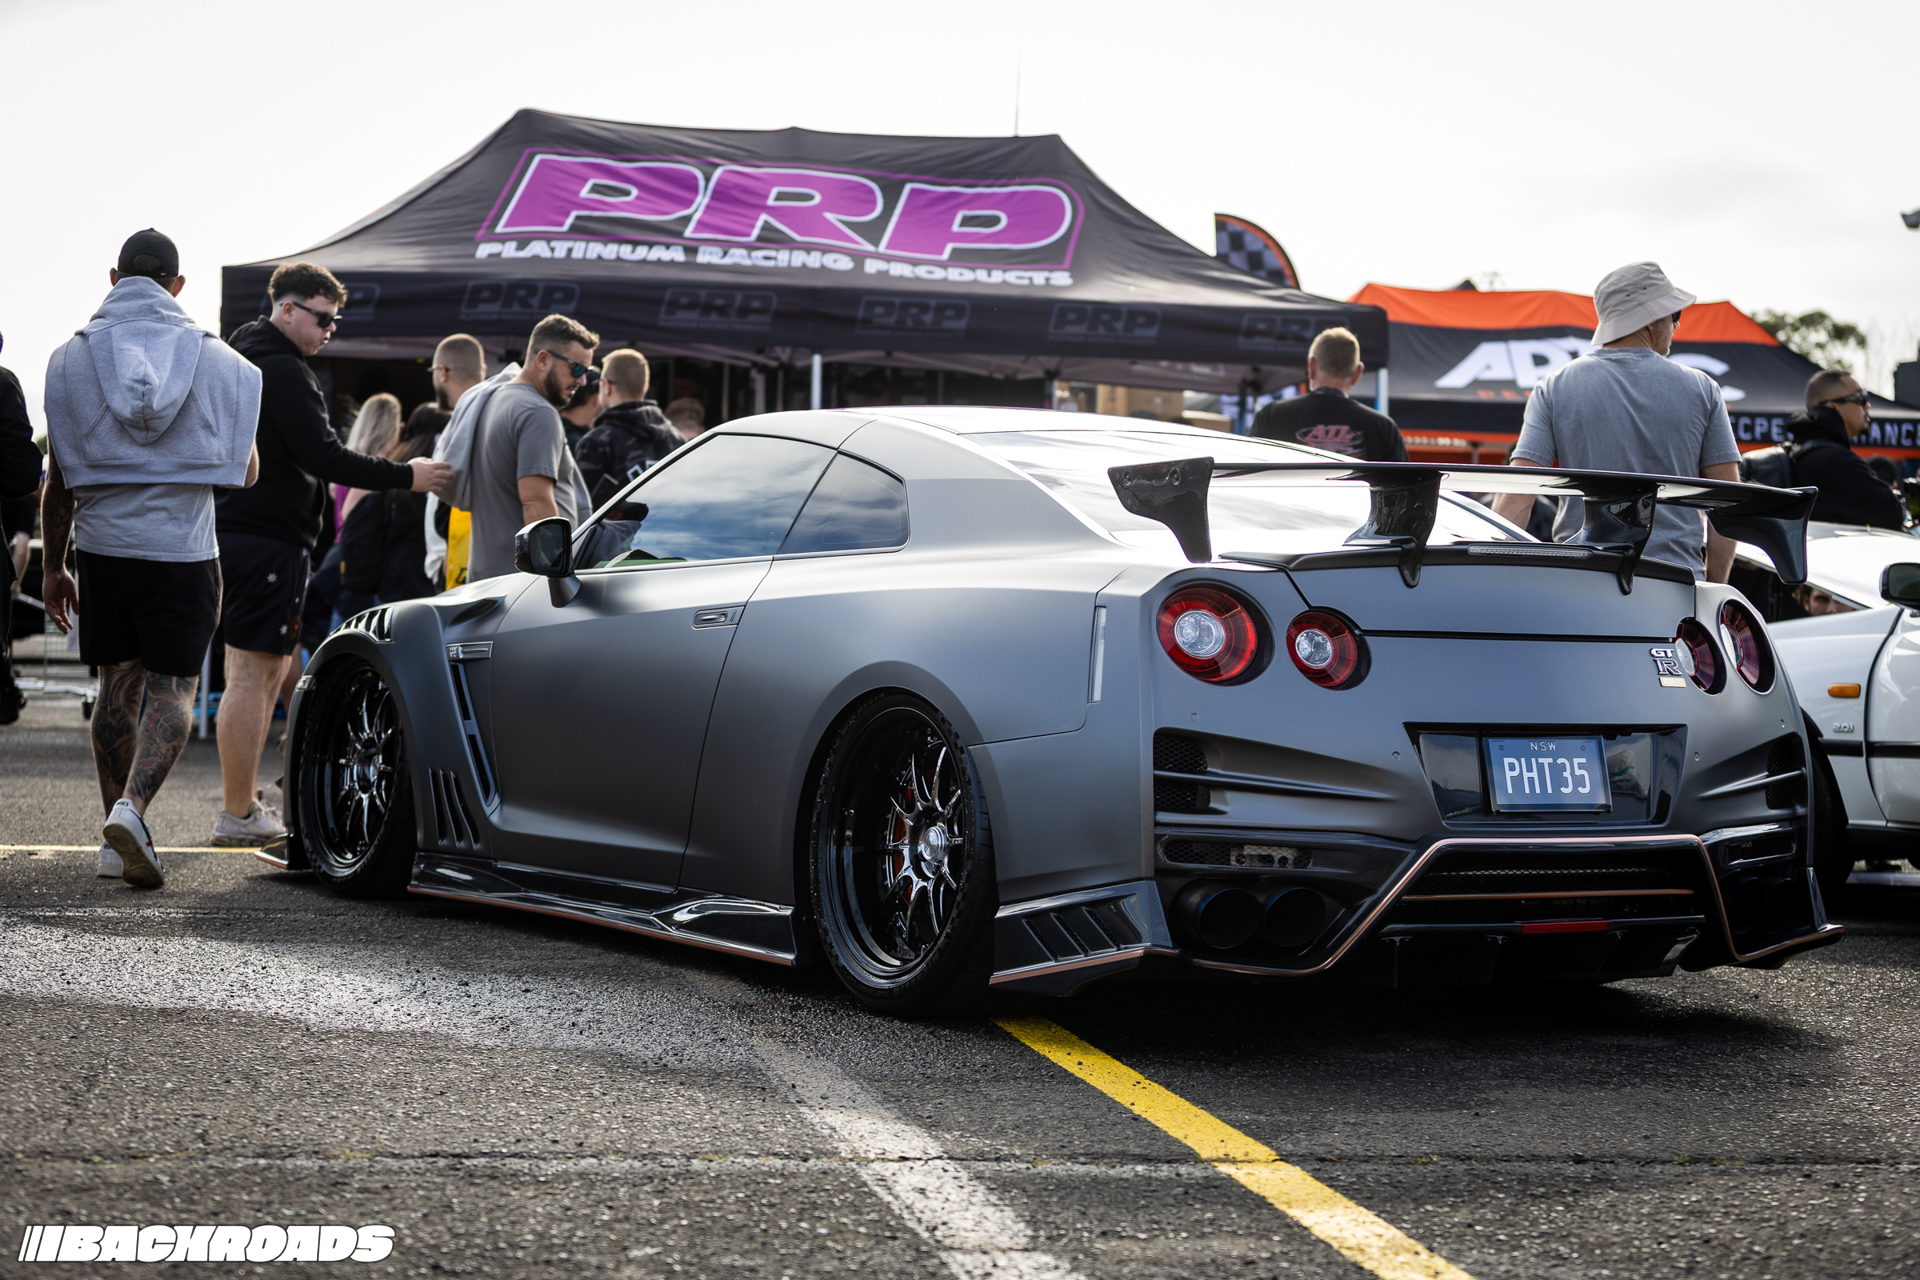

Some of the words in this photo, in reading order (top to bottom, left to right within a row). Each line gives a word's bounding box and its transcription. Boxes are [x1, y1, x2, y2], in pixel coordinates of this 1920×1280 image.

[494, 153, 1073, 261] PRP
[475, 240, 686, 262] PLATINUM
[696, 245, 855, 271] RACING
[864, 258, 1074, 286] PRODUCTS
[464, 282, 578, 310] PRP
[662, 289, 775, 319] PRP
[860, 299, 968, 328] PRP
[1053, 306, 1160, 334] PRP
[1650, 648, 1675, 658] GT
[1653, 658, 1682, 676] R
[1529, 741, 1557, 751] NSW
[1503, 757, 1591, 794] PHT35
